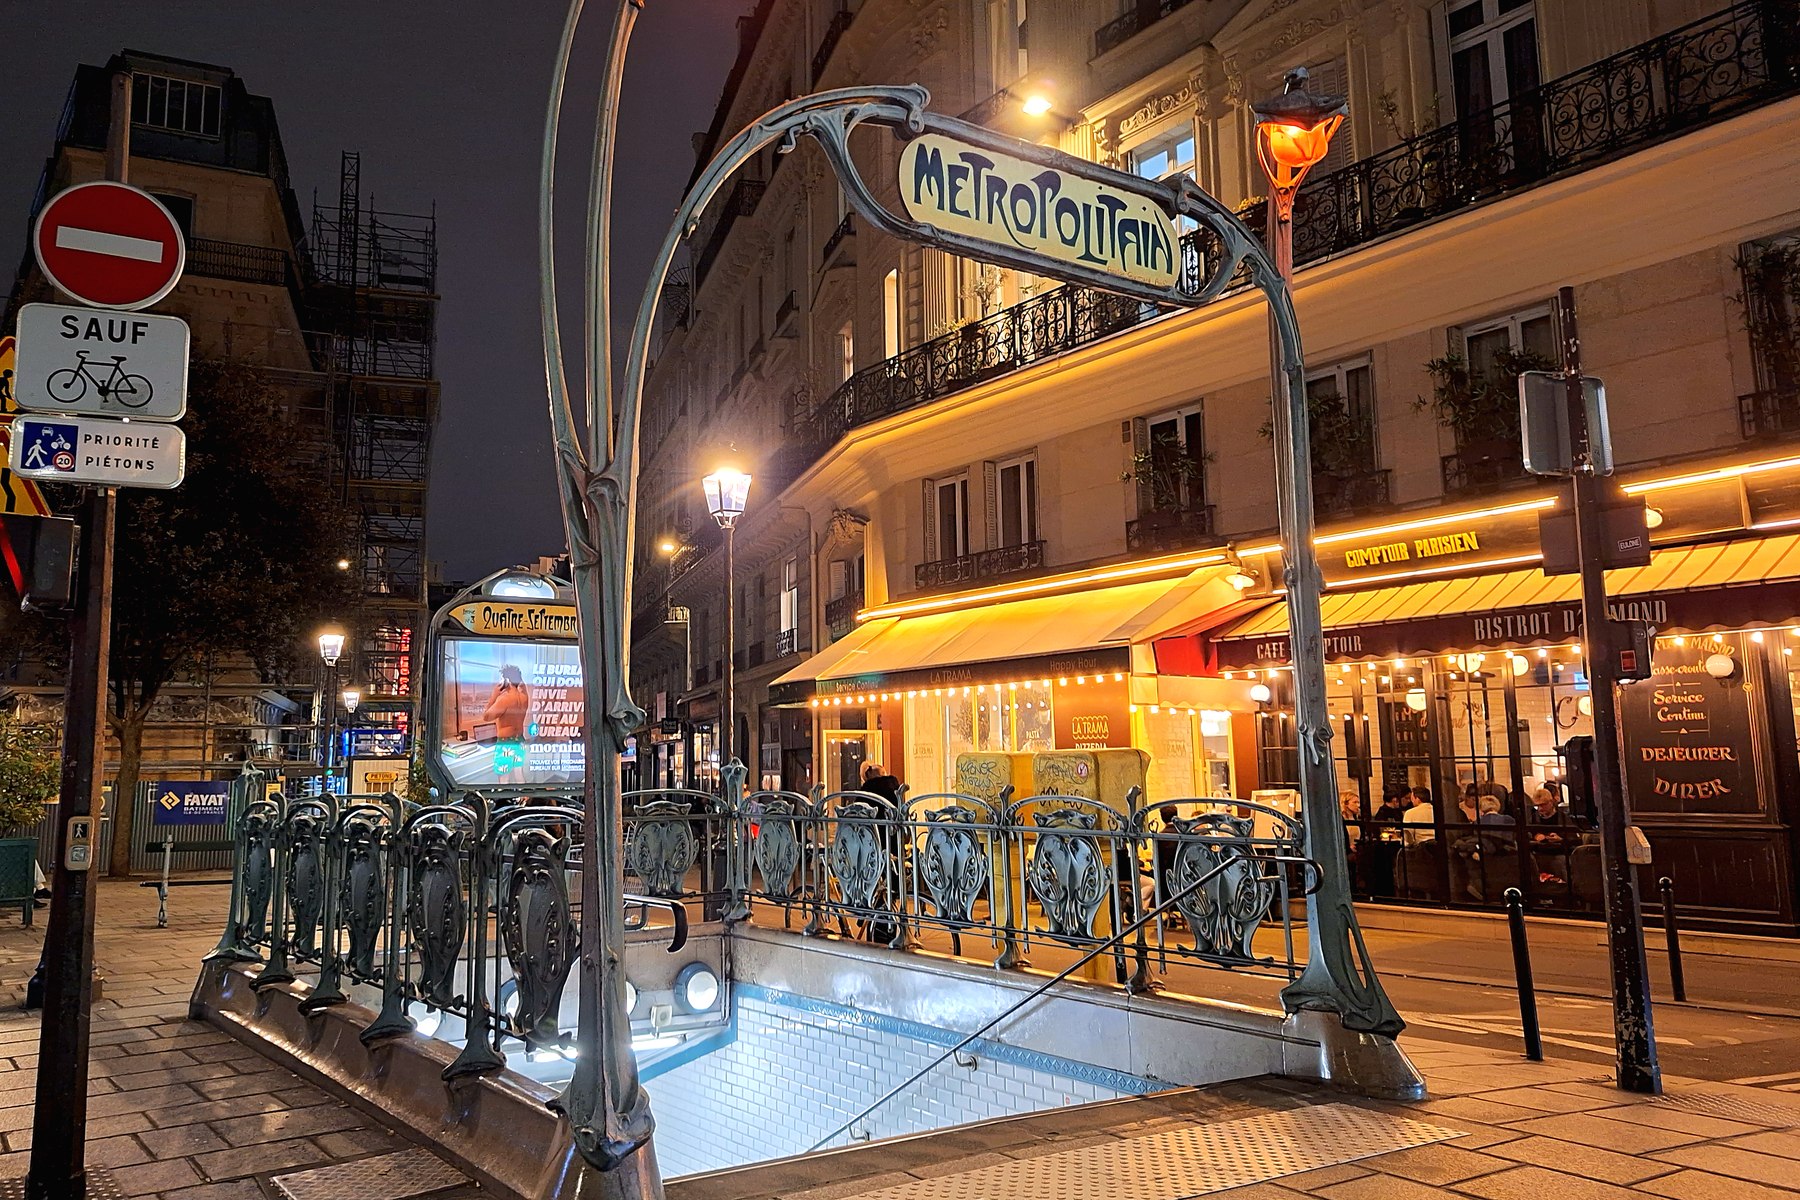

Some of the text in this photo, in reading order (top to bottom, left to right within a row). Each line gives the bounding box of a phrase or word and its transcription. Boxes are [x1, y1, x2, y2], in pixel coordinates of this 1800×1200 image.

[914, 143, 1173, 275] METROPOLITAIN
[59, 315, 149, 345] SAUF
[84, 434, 160, 449] PRIORITÉ
[58, 457, 69, 465] 20
[85, 456, 155, 470] PIÉTONS
[1345, 531, 1480, 568] COMPTOIR PARISIEN
[1474, 612, 1551, 641] BISTROT
[1256, 635, 1362, 660] CAFE PTOIR
[1691, 637, 1735, 656] MAISON
[533, 664, 546, 675] LE
[1050, 658, 1097, 672] Happy Hour
[532, 676, 556, 687] QUI
[930, 669, 973, 684] LA TRAMA
[532, 689, 567, 700] ENVIE
[1653, 690, 1705, 705] Service
[532, 713, 578, 725] VITE AU
[1657, 707, 1707, 722] Continu
[1026, 730, 1040, 739] PASTA
[1072, 721, 1109, 734] LA TRAMA
[1641, 747, 1737, 762] DEJEUNER
[1654, 777, 1732, 799] DINER
[184, 794, 226, 806] FAYAT
